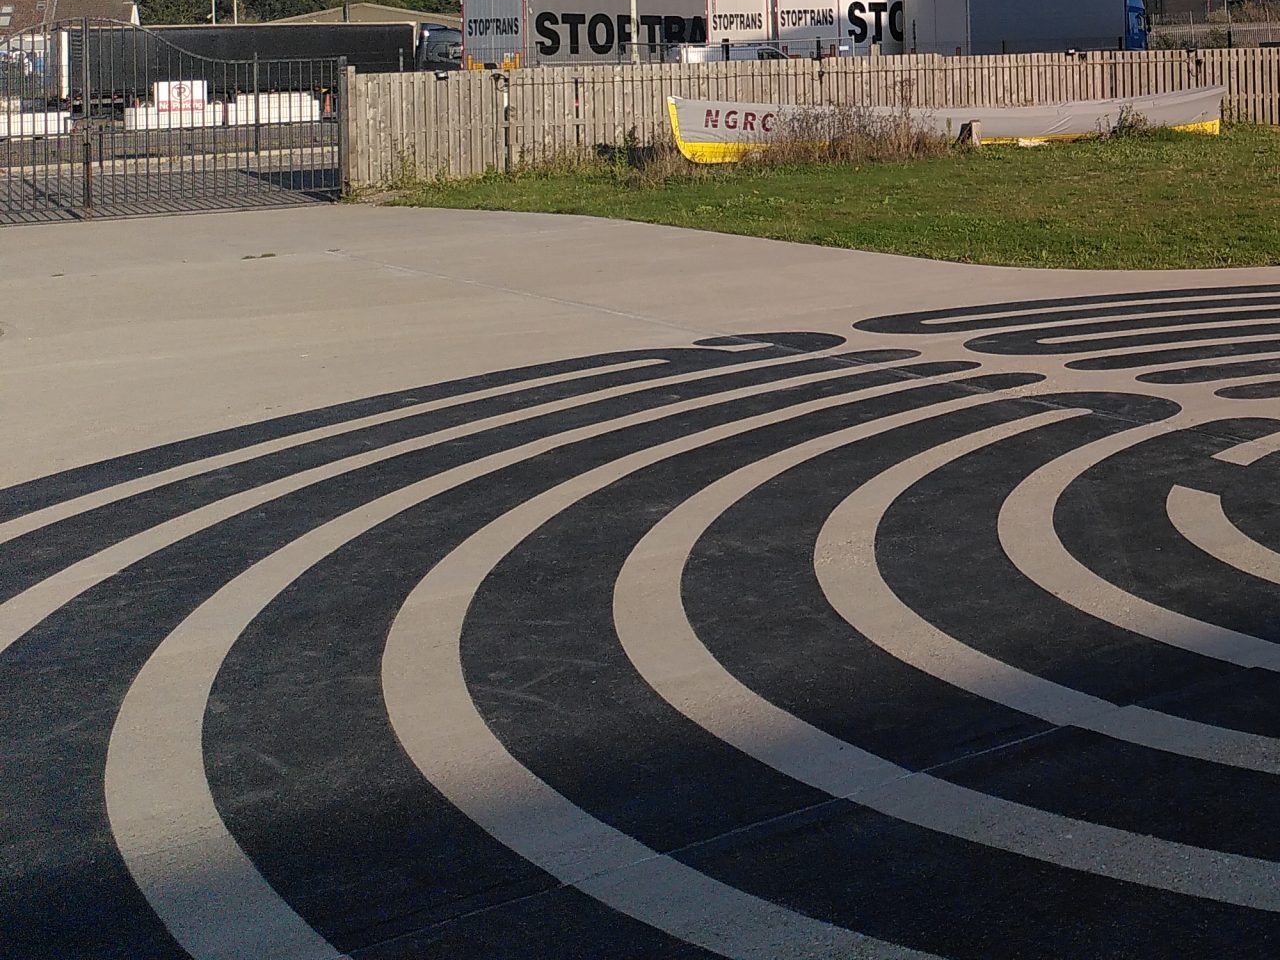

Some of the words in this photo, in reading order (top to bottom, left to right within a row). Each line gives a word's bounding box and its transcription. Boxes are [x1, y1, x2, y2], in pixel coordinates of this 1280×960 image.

[467, 17, 519, 37] STOPTRANS
[712, 12, 763, 32] STOPTRANS
[780, 8, 834, 28] STOPTRANS
[847, 1, 903, 44] STO
[535, 11, 706, 56] STOPTRA
[173, 101, 203, 110] Parkng
[704, 109, 774, 132] NGRC
